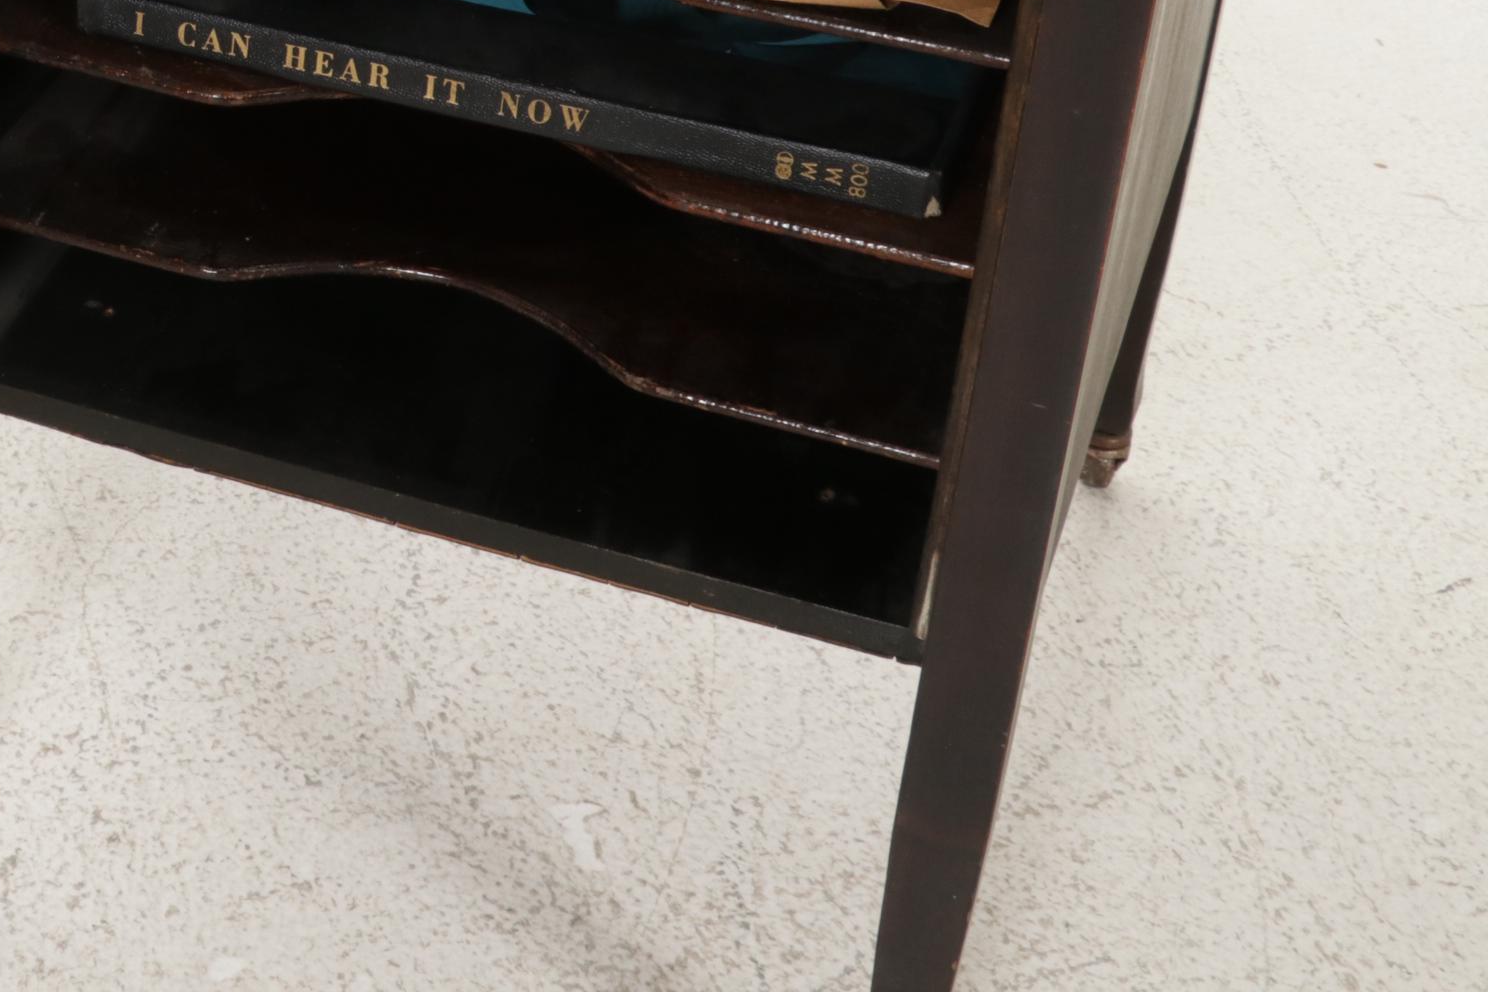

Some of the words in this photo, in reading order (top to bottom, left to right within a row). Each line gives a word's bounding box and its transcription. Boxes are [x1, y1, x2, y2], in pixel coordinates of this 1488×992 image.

[132, 10, 146, 38] I
[177, 21, 252, 59] CAN
[282, 43, 390, 90] HEAR
[422, 74, 465, 106] IT
[497, 90, 591, 132] NOW
[799, 161, 819, 182] M
[823, 166, 845, 187] M
[847, 162, 871, 199] 800
